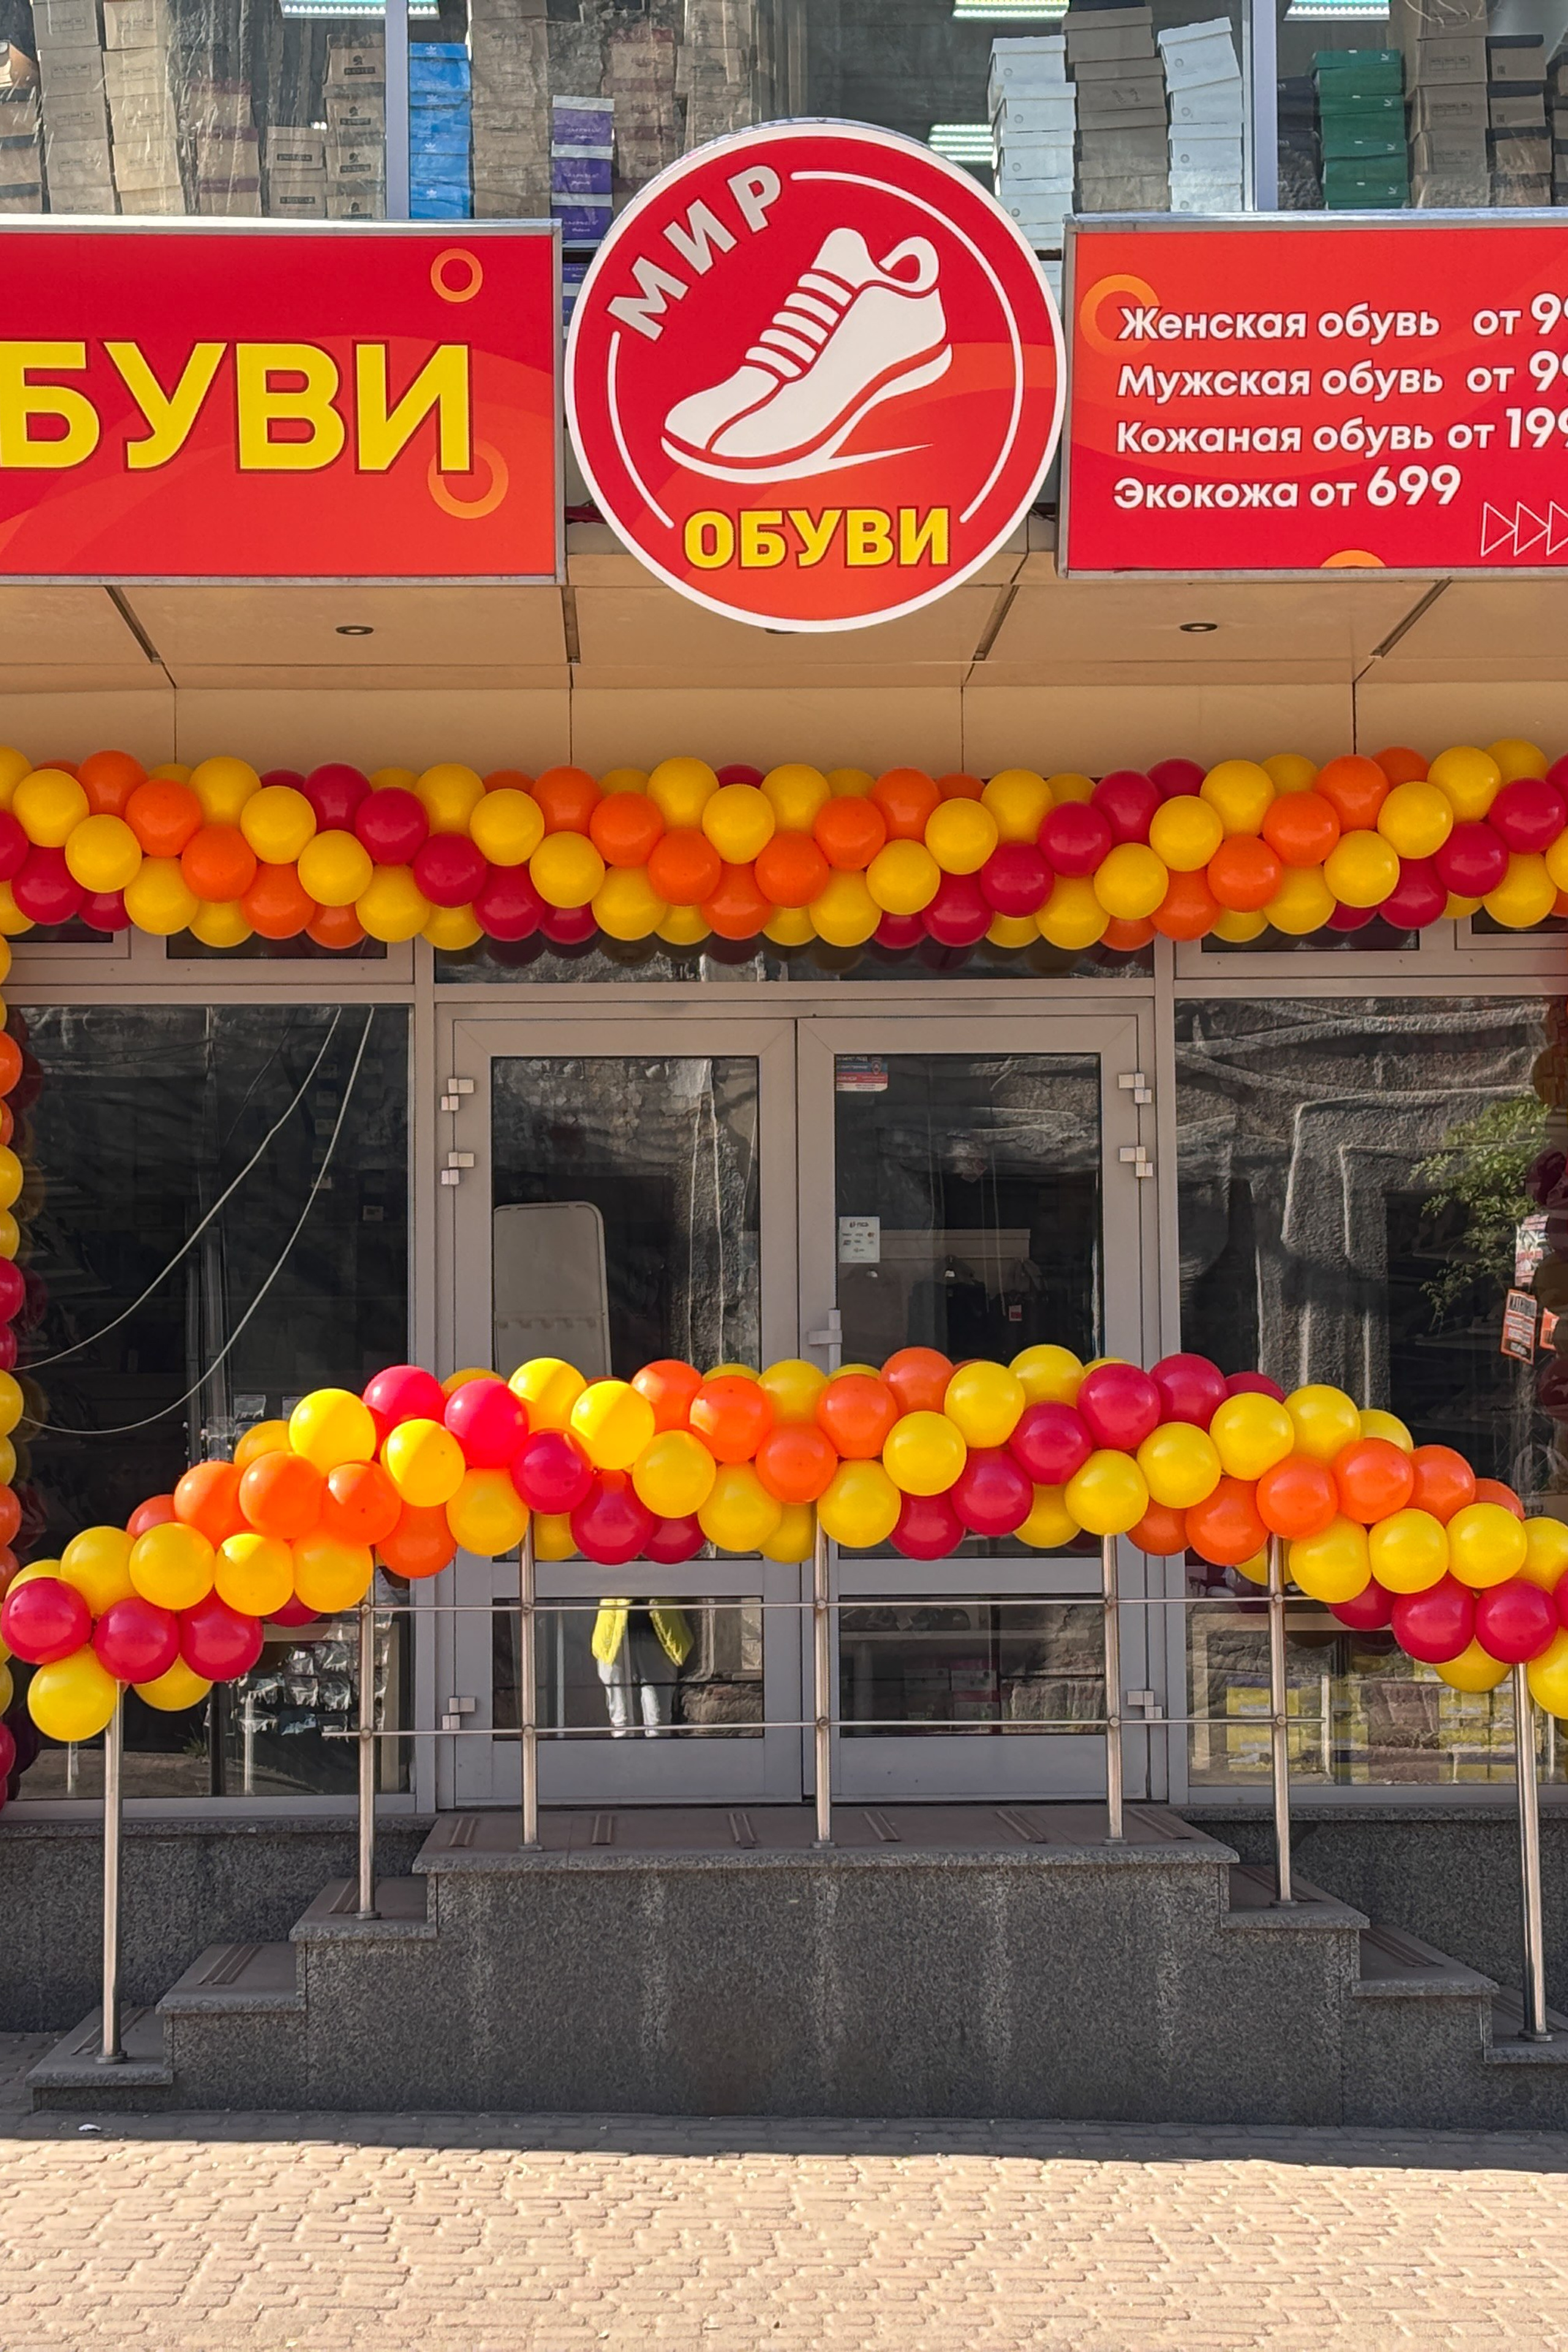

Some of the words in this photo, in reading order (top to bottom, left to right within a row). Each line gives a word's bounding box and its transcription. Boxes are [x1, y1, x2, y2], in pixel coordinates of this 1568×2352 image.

[607, 165, 781, 341] МИР
[1119, 307, 1306, 339] Женская
[1318, 303, 1440, 345] обувь
[1473, 310, 1521, 336] от
[1531, 293, 1568, 334] 9
[1118, 365, 1310, 404] Мужская
[1322, 360, 1443, 402] обувь
[1466, 368, 1515, 393] от
[1529, 350, 1568, 391] 9
[0, 341, 470, 471] БУВИ
[1117, 422, 1301, 453] Кожаная
[1313, 417, 1434, 458] обувь
[1447, 424, 1494, 449] от
[1114, 478, 1298, 509] Экокожа
[1310, 483, 1357, 507] от
[1367, 464, 1461, 507] 699
[685, 509, 948, 568] ОБУВИ
